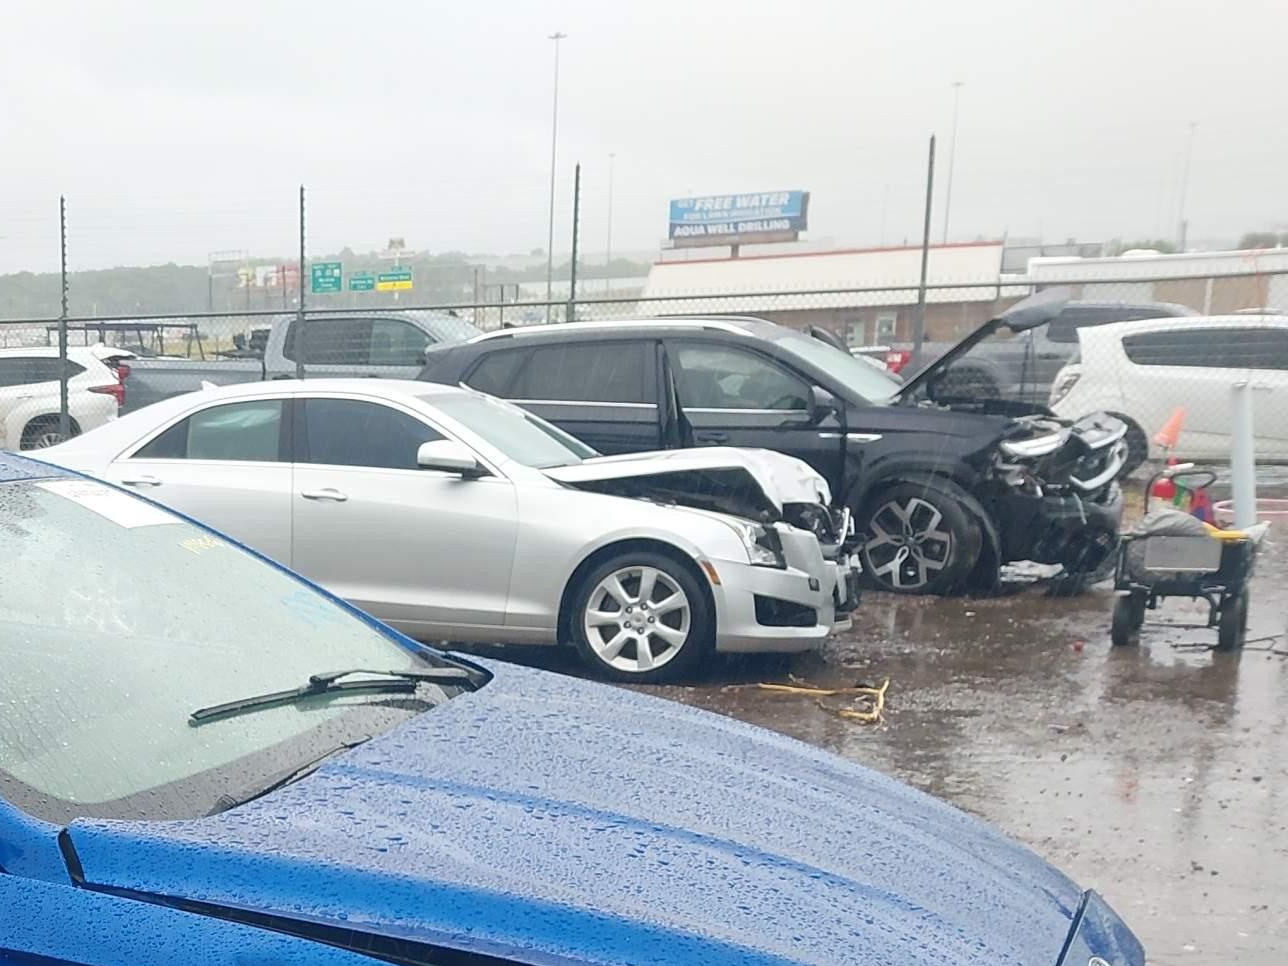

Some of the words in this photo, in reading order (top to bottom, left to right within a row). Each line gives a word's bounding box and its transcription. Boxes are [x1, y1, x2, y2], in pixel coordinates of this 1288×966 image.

[695, 197, 733, 211] FREE
[736, 192, 790, 209] WATER
[674, 224, 706, 237] AQUA
[707, 222, 736, 235] WELL
[738, 219, 791, 233] DRILLING
